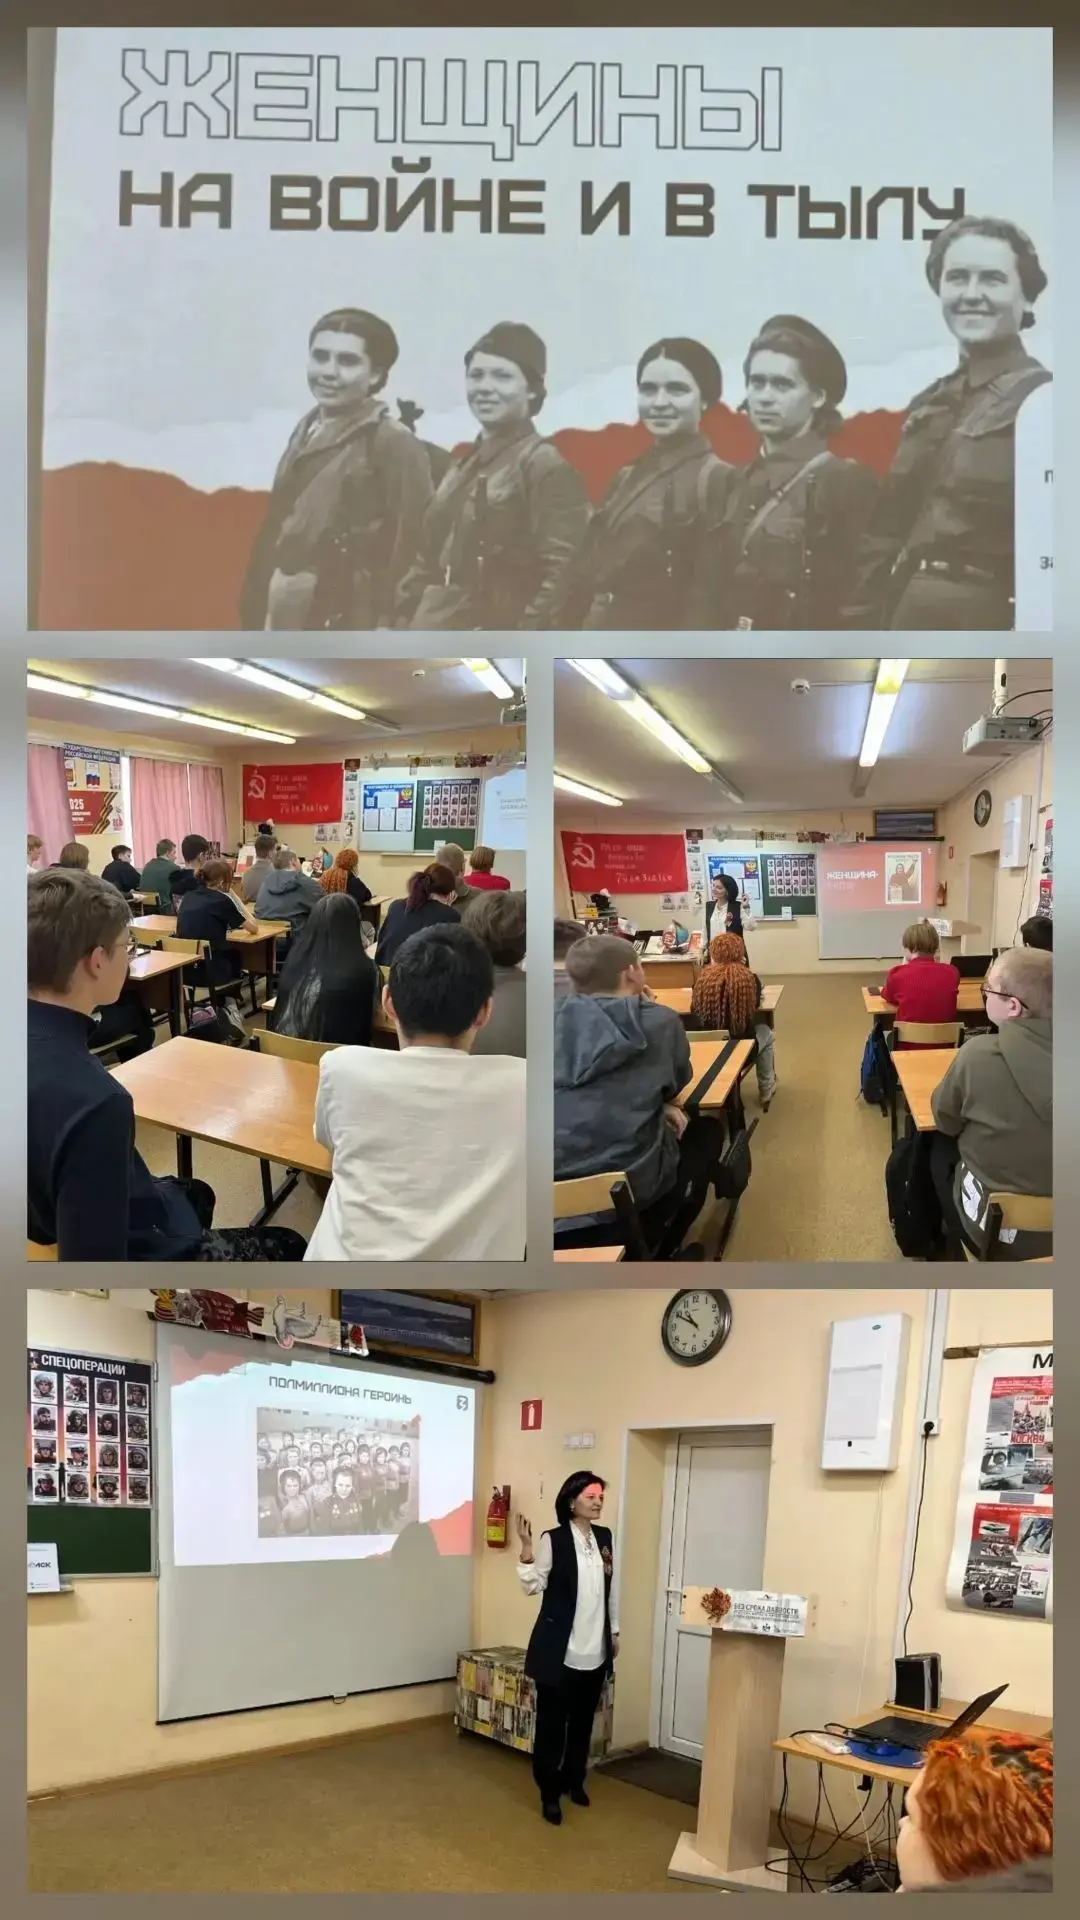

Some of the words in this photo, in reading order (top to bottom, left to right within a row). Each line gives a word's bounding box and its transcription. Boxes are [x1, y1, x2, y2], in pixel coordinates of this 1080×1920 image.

[119, 48, 783, 161] ЖЕНЩИНЫ
[119, 169, 232, 229] НА
[270, 156, 546, 235] ВОЙНЕ
[581, 180, 631, 236] И
[665, 182, 715, 237] В
[747, 184, 965, 241] ТЫЛУ
[41, 1353, 126, 1376] СПЕЦОПЕРАЦИИ
[269, 1375, 360, 1398] ПОЛМИЛЛИОНА
[363, 1389, 412, 1405] ГЕРОИНЬ
[733, 1602, 745, 1610] БЕЗ
